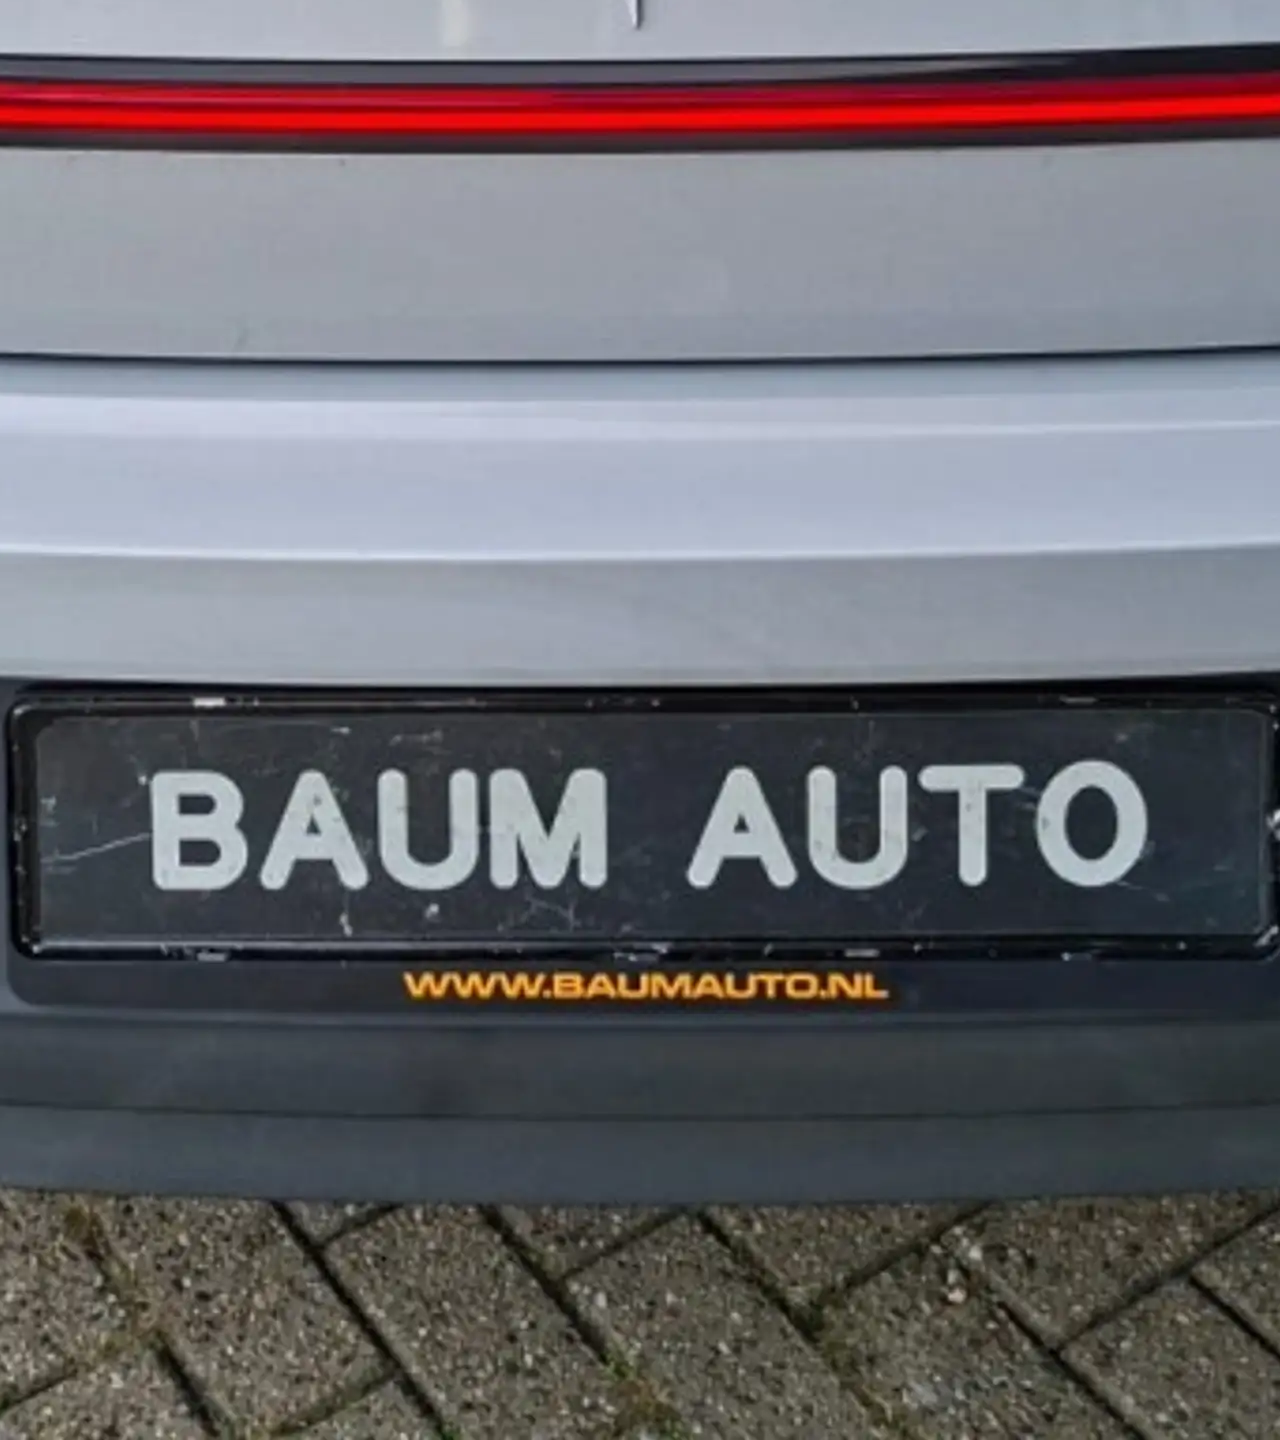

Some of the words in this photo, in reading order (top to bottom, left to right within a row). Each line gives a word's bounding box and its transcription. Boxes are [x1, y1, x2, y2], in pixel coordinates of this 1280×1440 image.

[150, 768, 608, 890] BAUM
[686, 759, 1148, 890] AUTO
[402, 971, 889, 1001] WWW.BAUMAUTO.NL
